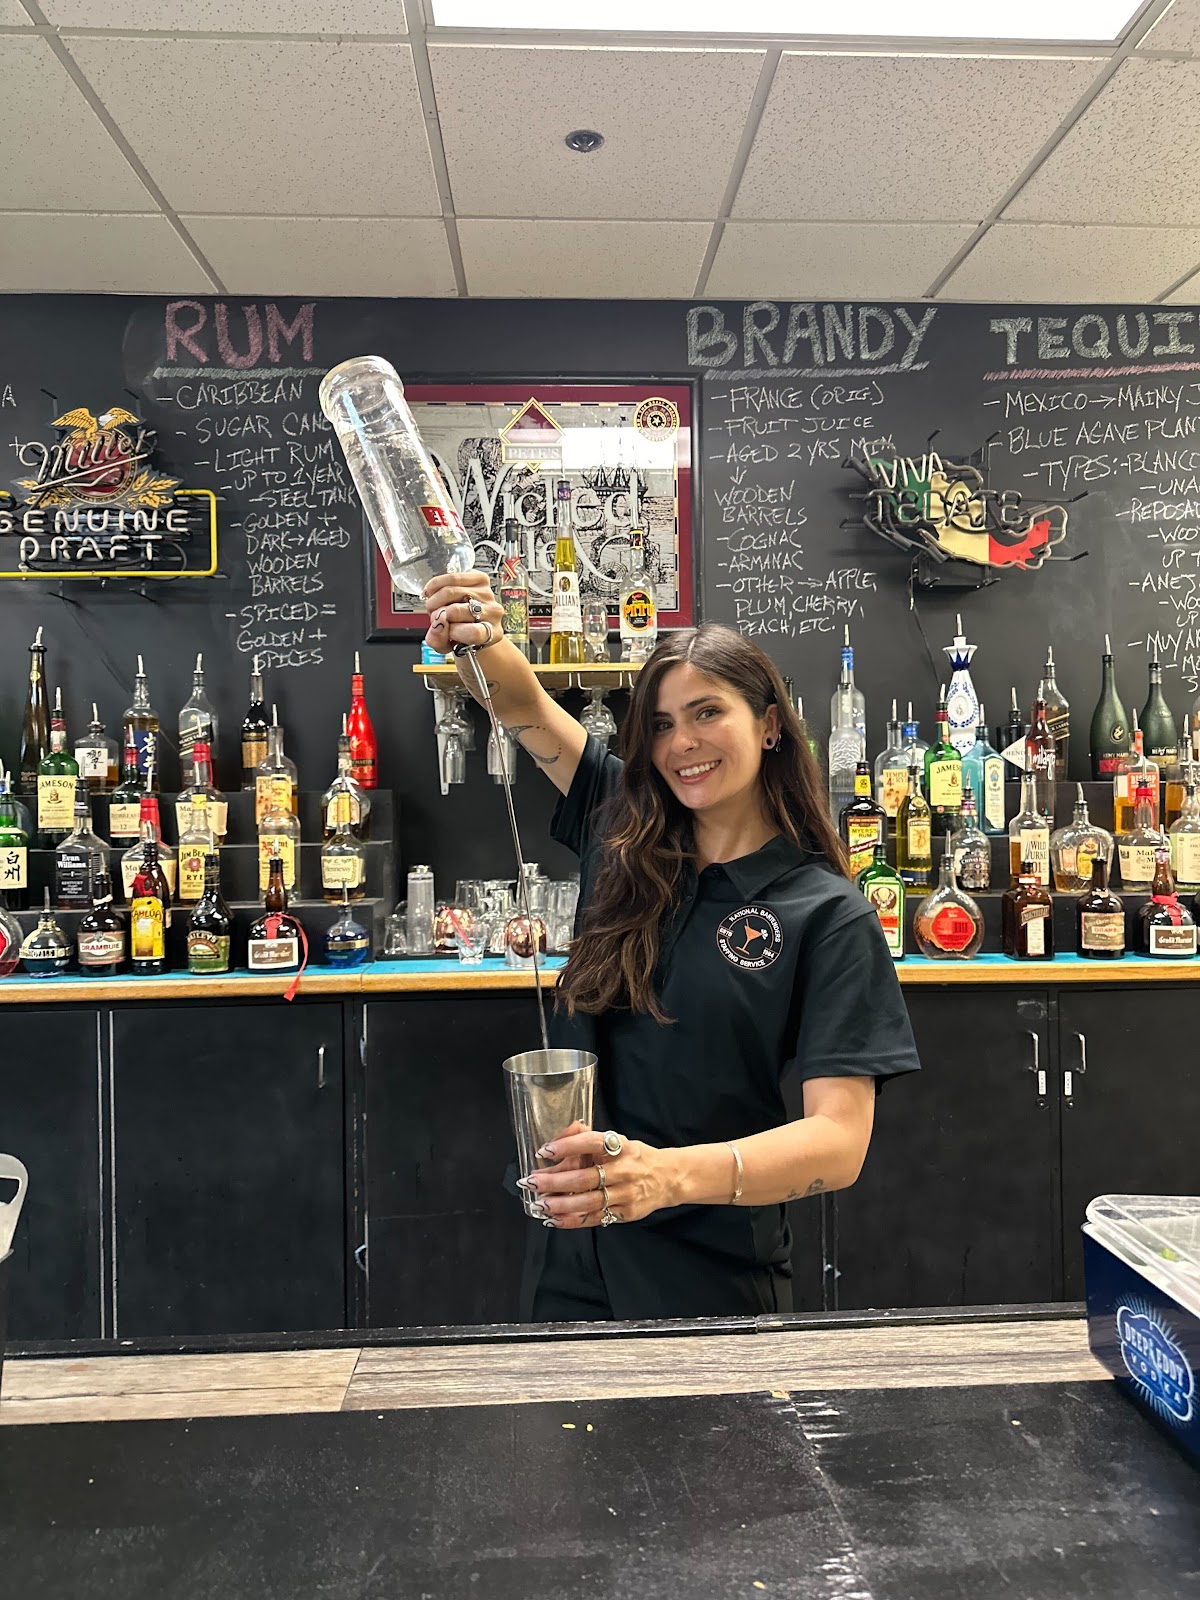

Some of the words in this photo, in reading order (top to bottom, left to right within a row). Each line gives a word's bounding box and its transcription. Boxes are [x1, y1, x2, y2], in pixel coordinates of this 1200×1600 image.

[165, 300, 316, 368] RUM
[686, 301, 939, 367] BRANDY
[990, 312, 1200, 365] TEQUI
[176, 379, 303, 409] CARIBBEAN
[1005, 391, 1089, 418] MEXICO
[196, 415, 272, 444] SUGAR
[724, 416, 799, 438] FRUIT
[801, 416, 875, 434] JUICE
[1008, 426, 1069, 455] BLUE
[1075, 420, 1140, 445] AGAVE
[1144, 415, 1200, 441] PLAN
[18, 429, 157, 484] Miller
[215, 447, 281, 472] LIGHT
[286, 438, 335, 468] RUM
[509, 447, 561, 460] PETE'S
[726, 443, 778, 464] AGED
[787, 444, 802, 460] 2
[807, 438, 840, 467] YRS
[235, 470, 257, 490] UP
[261, 471, 287, 486] TO
[306, 462, 346, 496] YEAR
[877, 451, 944, 488] VIVA
[714, 480, 795, 507] WOODEN
[1158, 475, 1200, 497] UNA
[243, 511, 309, 533] GOLDEN
[722, 504, 808, 527] BARRELS
[19, 534, 163, 562] DRAFT
[246, 530, 292, 555] DARK
[306, 525, 351, 548] AGED
[727, 527, 802, 553] COGNAC
[247, 553, 320, 575] WOODEN
[728, 550, 804, 573] ARMANAC
[1162, 548, 1186, 569] UP
[249, 571, 324, 597] BARRELS
[732, 574, 795, 595] OTHER
[1141, 571, 1200, 594] ANEJ
[240, 601, 318, 628] SPICED
[236, 628, 304, 652] GOLDEN
[936, 764, 962, 774] JAMES
[61, 854, 81, 862] Evan
[192, 848, 206, 858] BEA
[728, 907, 759, 922] NATIONAL
[81, 943, 120, 951] DRAMBUIE
[739, 958, 766, 968] SERVICE
[1124, 1322, 1149, 1356] DEEP
[1155, 1347, 1185, 1388] EDDY
[1130, 1352, 1181, 1404] VODKA
